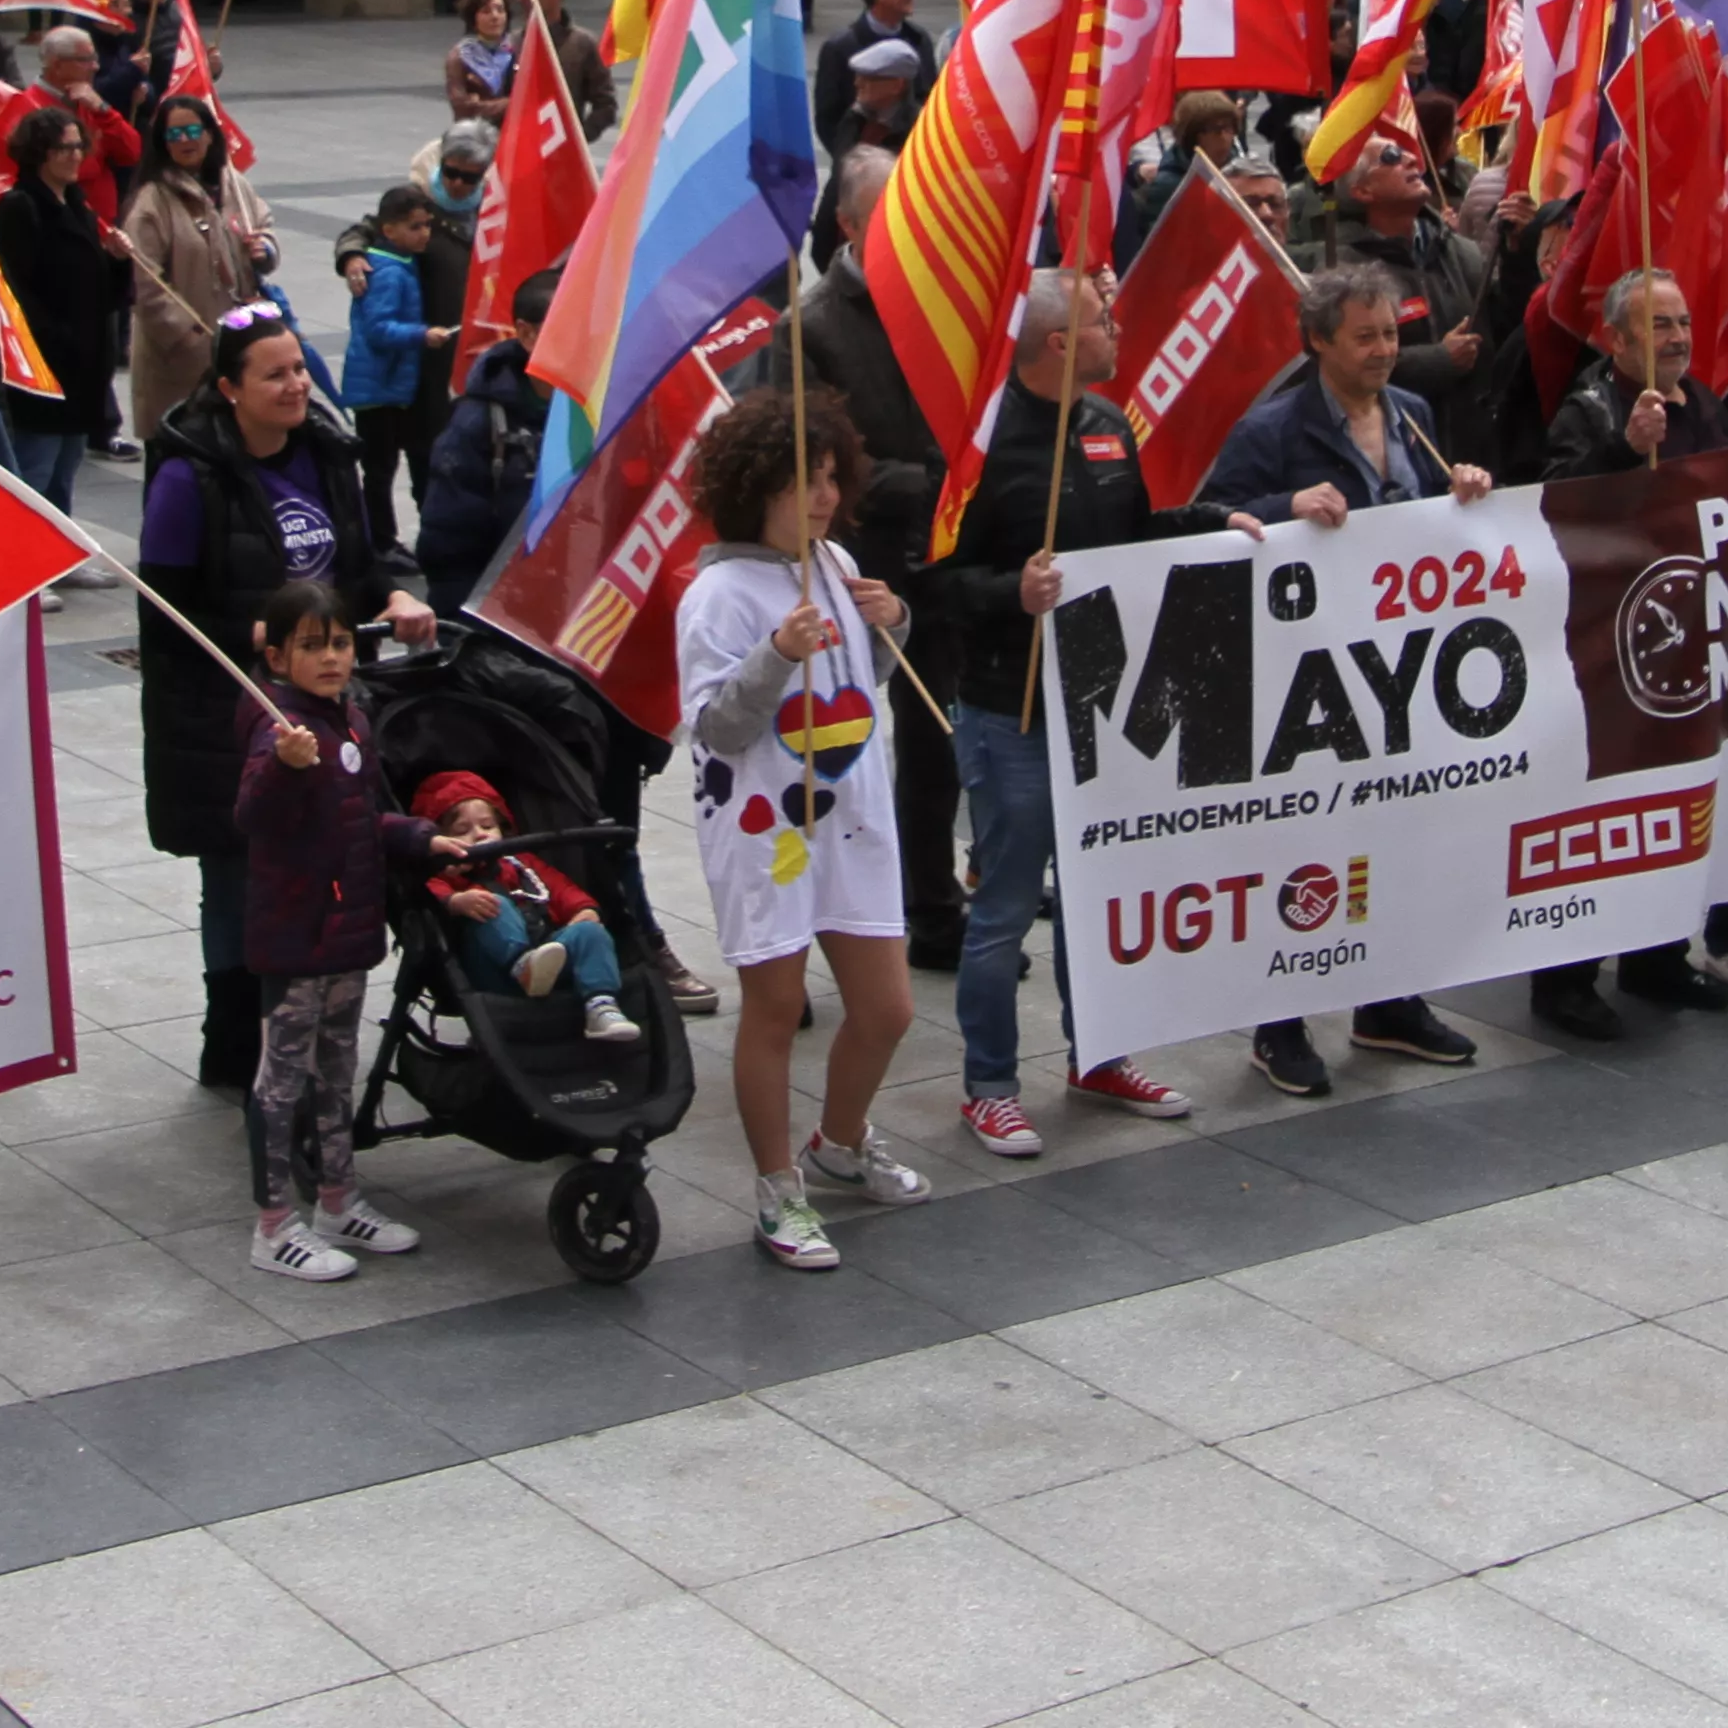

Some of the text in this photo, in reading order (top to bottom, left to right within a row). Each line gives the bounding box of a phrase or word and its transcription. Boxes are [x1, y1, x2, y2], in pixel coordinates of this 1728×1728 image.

[1138, 241, 1261, 416] CCOO
[280, 517, 308, 534] UGT
[1373, 544, 1526, 621] 2024
[1080, 788, 1320, 852] #PLENOEMPLEO
[1351, 750, 1530, 807] #1MAYO2024
[1520, 806, 1682, 881] CCOO
[1107, 872, 1264, 966] UGT
[1506, 894, 1597, 932] Aragón
[1268, 939, 1368, 977] Aragón
